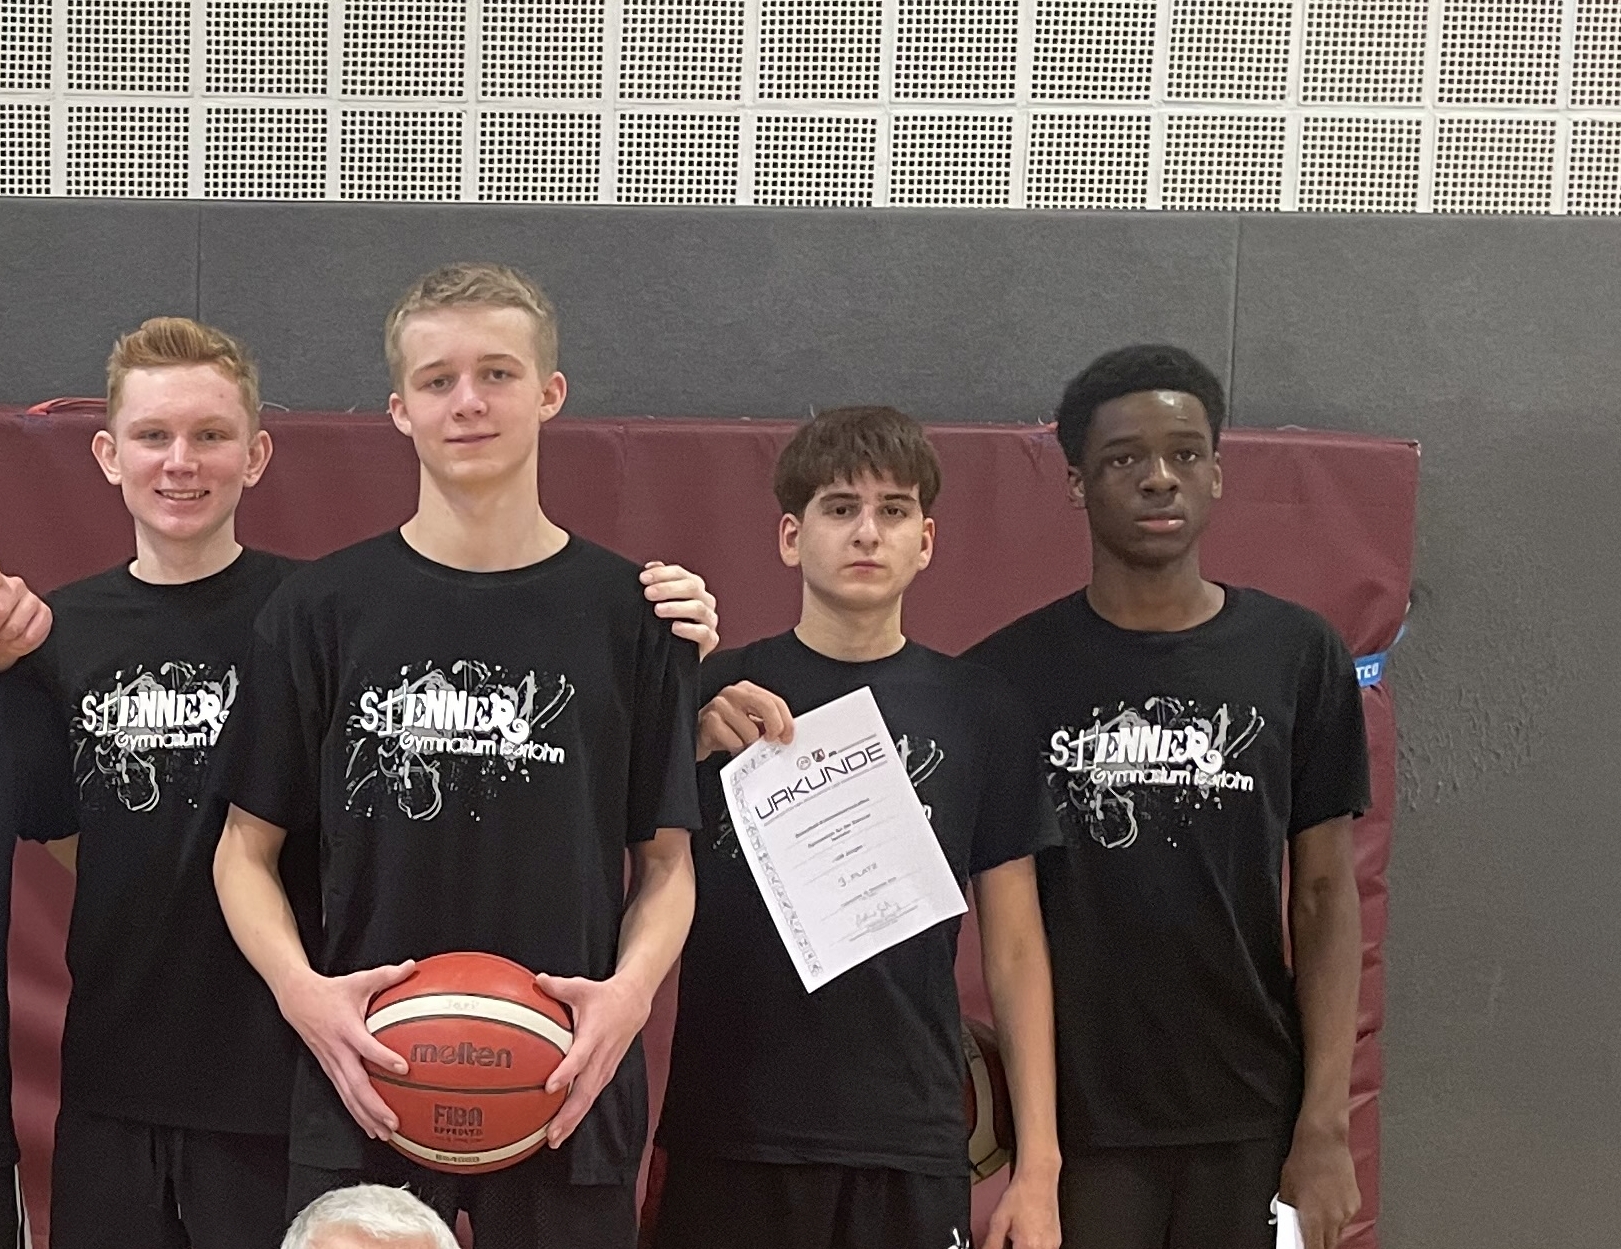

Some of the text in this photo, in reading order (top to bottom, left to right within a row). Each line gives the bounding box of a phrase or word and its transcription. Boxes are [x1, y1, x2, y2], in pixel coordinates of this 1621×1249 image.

[82, 685, 230, 737] STENNER
[360, 684, 530, 744] STENNER
[115, 731, 207, 751] Gymnasium
[399, 731, 497, 756] Gymnasium
[1050, 722, 1223, 775] STENNER
[755, 742, 887, 821] URKUNDE
[1090, 766, 1191, 787] Gymnasium
[409, 1041, 512, 1069] molten
[434, 1104, 483, 1127] FIBA
